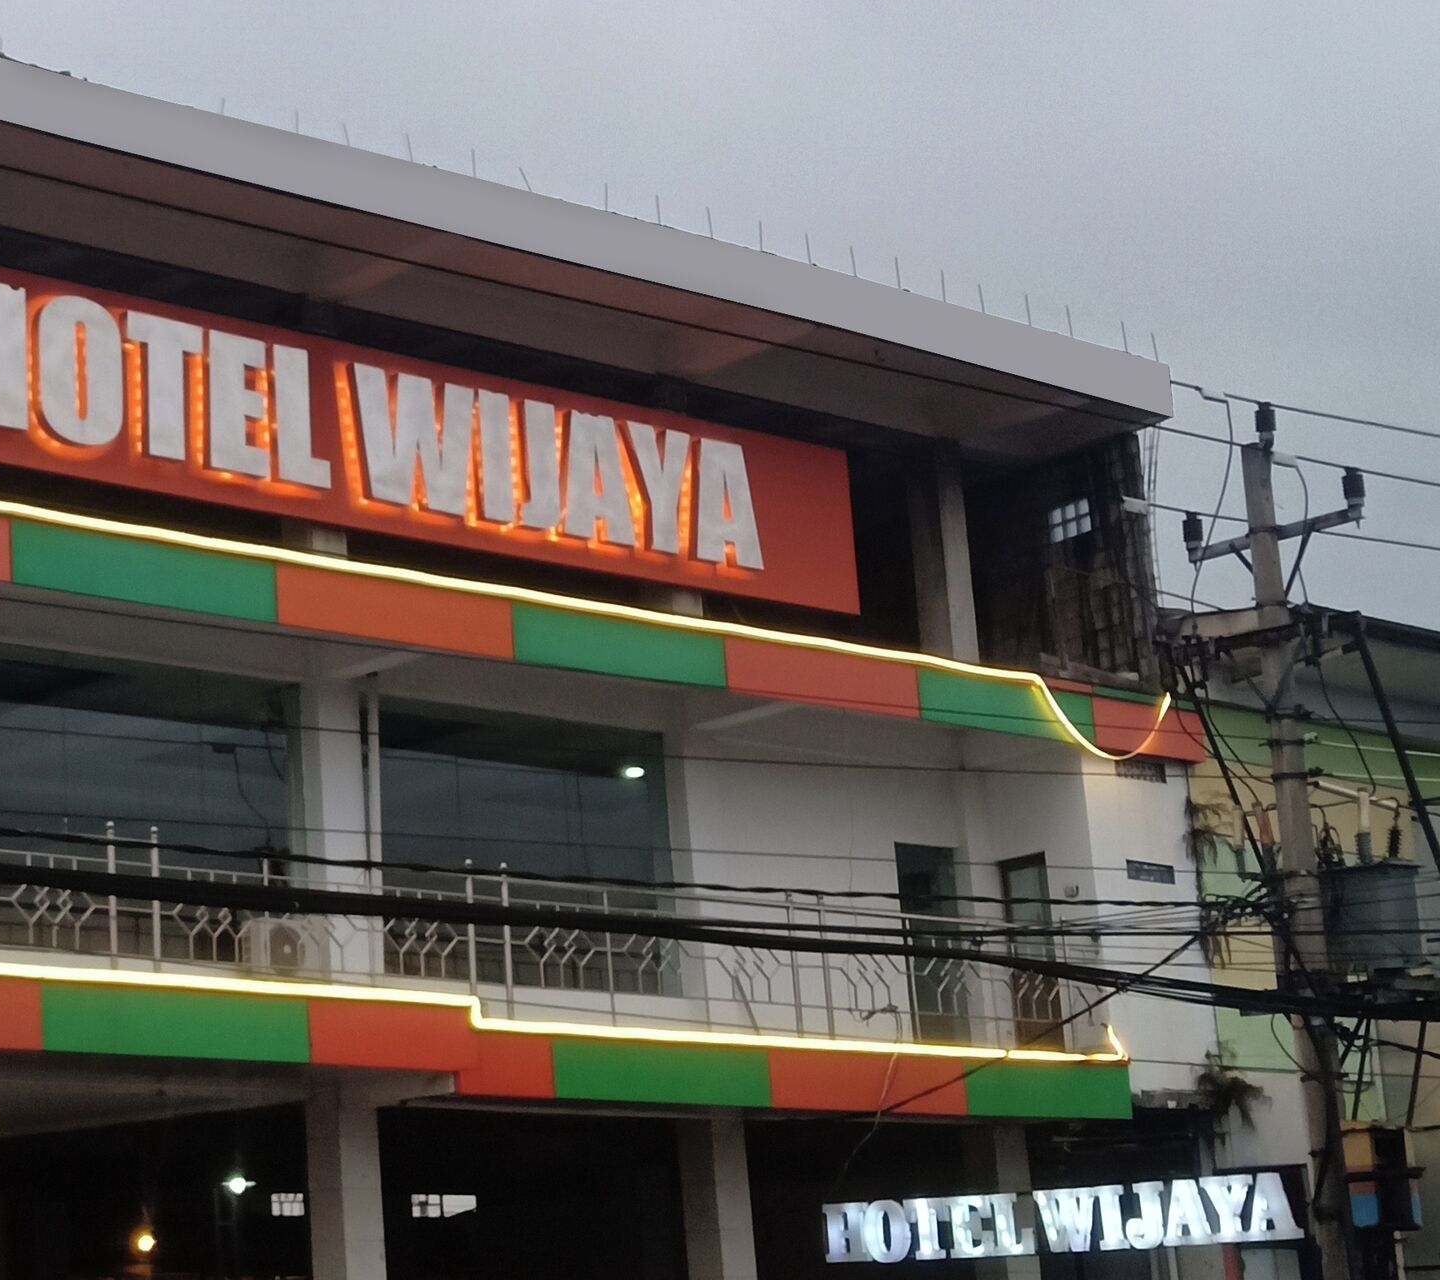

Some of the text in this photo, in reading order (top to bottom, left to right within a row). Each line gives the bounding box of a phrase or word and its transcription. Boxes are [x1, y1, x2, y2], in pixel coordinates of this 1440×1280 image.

[351, 361, 765, 571] WIJAYA
[822, 1172, 1306, 1264] HOTEL WIJAYA
